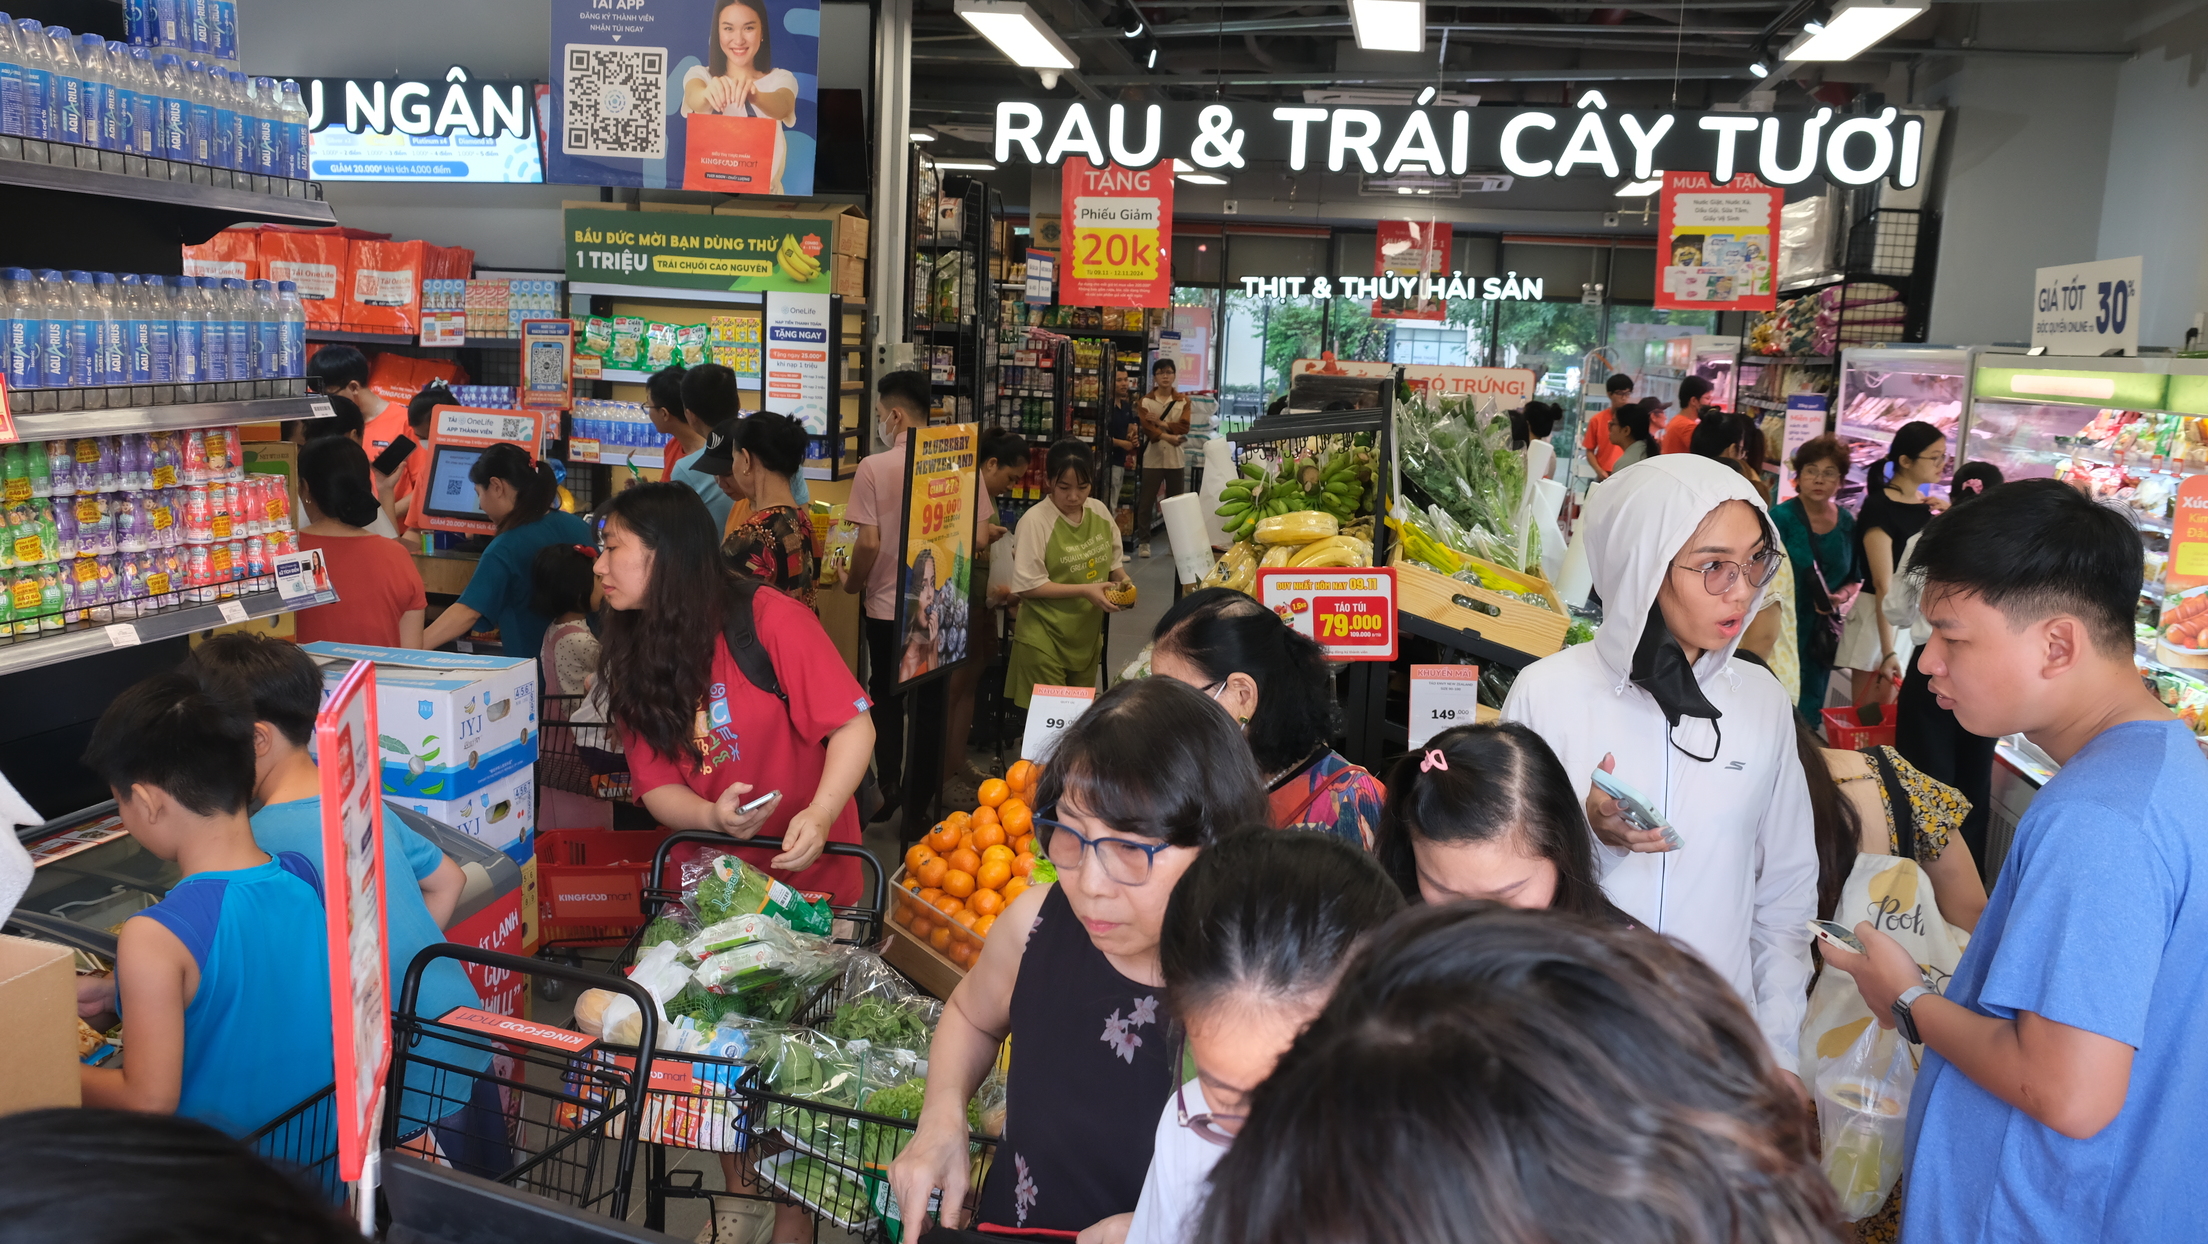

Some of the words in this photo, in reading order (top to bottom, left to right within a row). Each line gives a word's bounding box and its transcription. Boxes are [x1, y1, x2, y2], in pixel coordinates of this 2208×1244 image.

[579, 12, 601, 22] ĐĂNG
[602, 12, 611, 21] KÝ
[612, 12, 637, 22] THÀNH
[638, 13, 654, 22] VIÊN
[590, 24, 611, 34] NHẬN
[612, 24, 624, 33] TÚI
[625, 25, 644, 33] NGAY
[64, 81, 81, 134] AQUARIUS
[345, 66, 523, 139] NGÂN
[106, 88, 119, 140] AQUARIUS
[169, 102, 184, 150] AQUARIUS
[995, 101, 1162, 170] RAU
[1190, 104, 1246, 170] &
[1273, 86, 1470, 177] TRÁI
[1499, 87, 1676, 181] CÂY
[1698, 105, 1923, 188] TƯƠI
[261, 122, 272, 167] AQUARIUS
[300, 127, 309, 171] AQUARIUS
[330, 162, 352, 174] GIẢM
[383, 166, 394, 174] khi
[396, 166, 409, 174] tích
[432, 166, 451, 175] điểm
[1084, 166, 1151, 196] TẶNG
[1673, 176, 1707, 189] MUA
[1733, 174, 1772, 192] TẶN
[1081, 207, 1116, 220] Phiếu
[1120, 208, 1153, 221] Giảm
[575, 226, 602, 244] BẦU
[606, 229, 635, 246] ĐỨC
[638, 230, 666, 247] MỜI
[670, 234, 700, 251] BẠN
[703, 233, 744, 251] DÙNG
[747, 237, 780, 252] THỬ
[1081, 233, 1151, 267] 20k
[575, 251, 584, 267] 1
[588, 248, 648, 275] TRIỆU
[657, 258, 677, 269] TRÁI
[679, 257, 708, 271] CHUỐI
[709, 262, 728, 272] CAO
[730, 260, 768, 273] NGUYÊN
[304, 270, 335, 279] OneLife
[1239, 275, 1306, 305] THỊT
[1311, 275, 1331, 300] &
[1338, 269, 1418, 301] THỦY
[1426, 269, 1476, 301] HẢI
[1482, 270, 1544, 301] SẢN
[2038, 278, 2059, 313] GIÁ
[2061, 274, 2086, 311] TỐT
[789, 306, 817, 315] OneLife
[774, 328, 798, 340] TẶNG
[798, 331, 822, 340] NGAY
[12, 323, 26, 376] AQUARIUS
[49, 323, 62, 375] AQUARIUS
[110, 323, 123, 373] AQUARIUS
[139, 323, 150, 372] AQUARIUS
[773, 350, 787, 359] Tặng
[787, 352, 801, 360] ngay
[804, 361, 818, 369] triệu
[1452, 375, 1526, 396] TRỨNG!
[459, 426, 479, 434] THÀNH
[466, 417, 494, 427] OneLife
[922, 435, 971, 456] BLUEBERRY
[915, 453, 974, 476] NEWZEALAND
[430, 517, 446, 526] GIẢM
[476, 521, 487, 529] tích
[1060, 553, 1083, 564] USUALLY
[1069, 561, 1088, 573] GREAT
[1276, 581, 1292, 591] DUY
[1292, 578, 1313, 591] NHẤT
[1315, 579, 1331, 590] HÔM
[1332, 581, 1348, 591] NAY
[1349, 577, 1378, 591] 09.11
[1334, 600, 1350, 613] TÁO
[1352, 600, 1367, 613] TÚI
[1319, 613, 1382, 638] 79.000
[1417, 666, 1453, 678] KHUYẾN
[1455, 667, 1472, 678] MÃI
[1038, 687, 1071, 697] KHUYẾN
[459, 715, 482, 740] JYJ
[558, 892, 632, 903] KINGFOODmart
[1867, 895, 1926, 936] Pooh
[492, 908, 519, 947] LẠNH
[455, 1012, 584, 1045] KINGFOODmart
